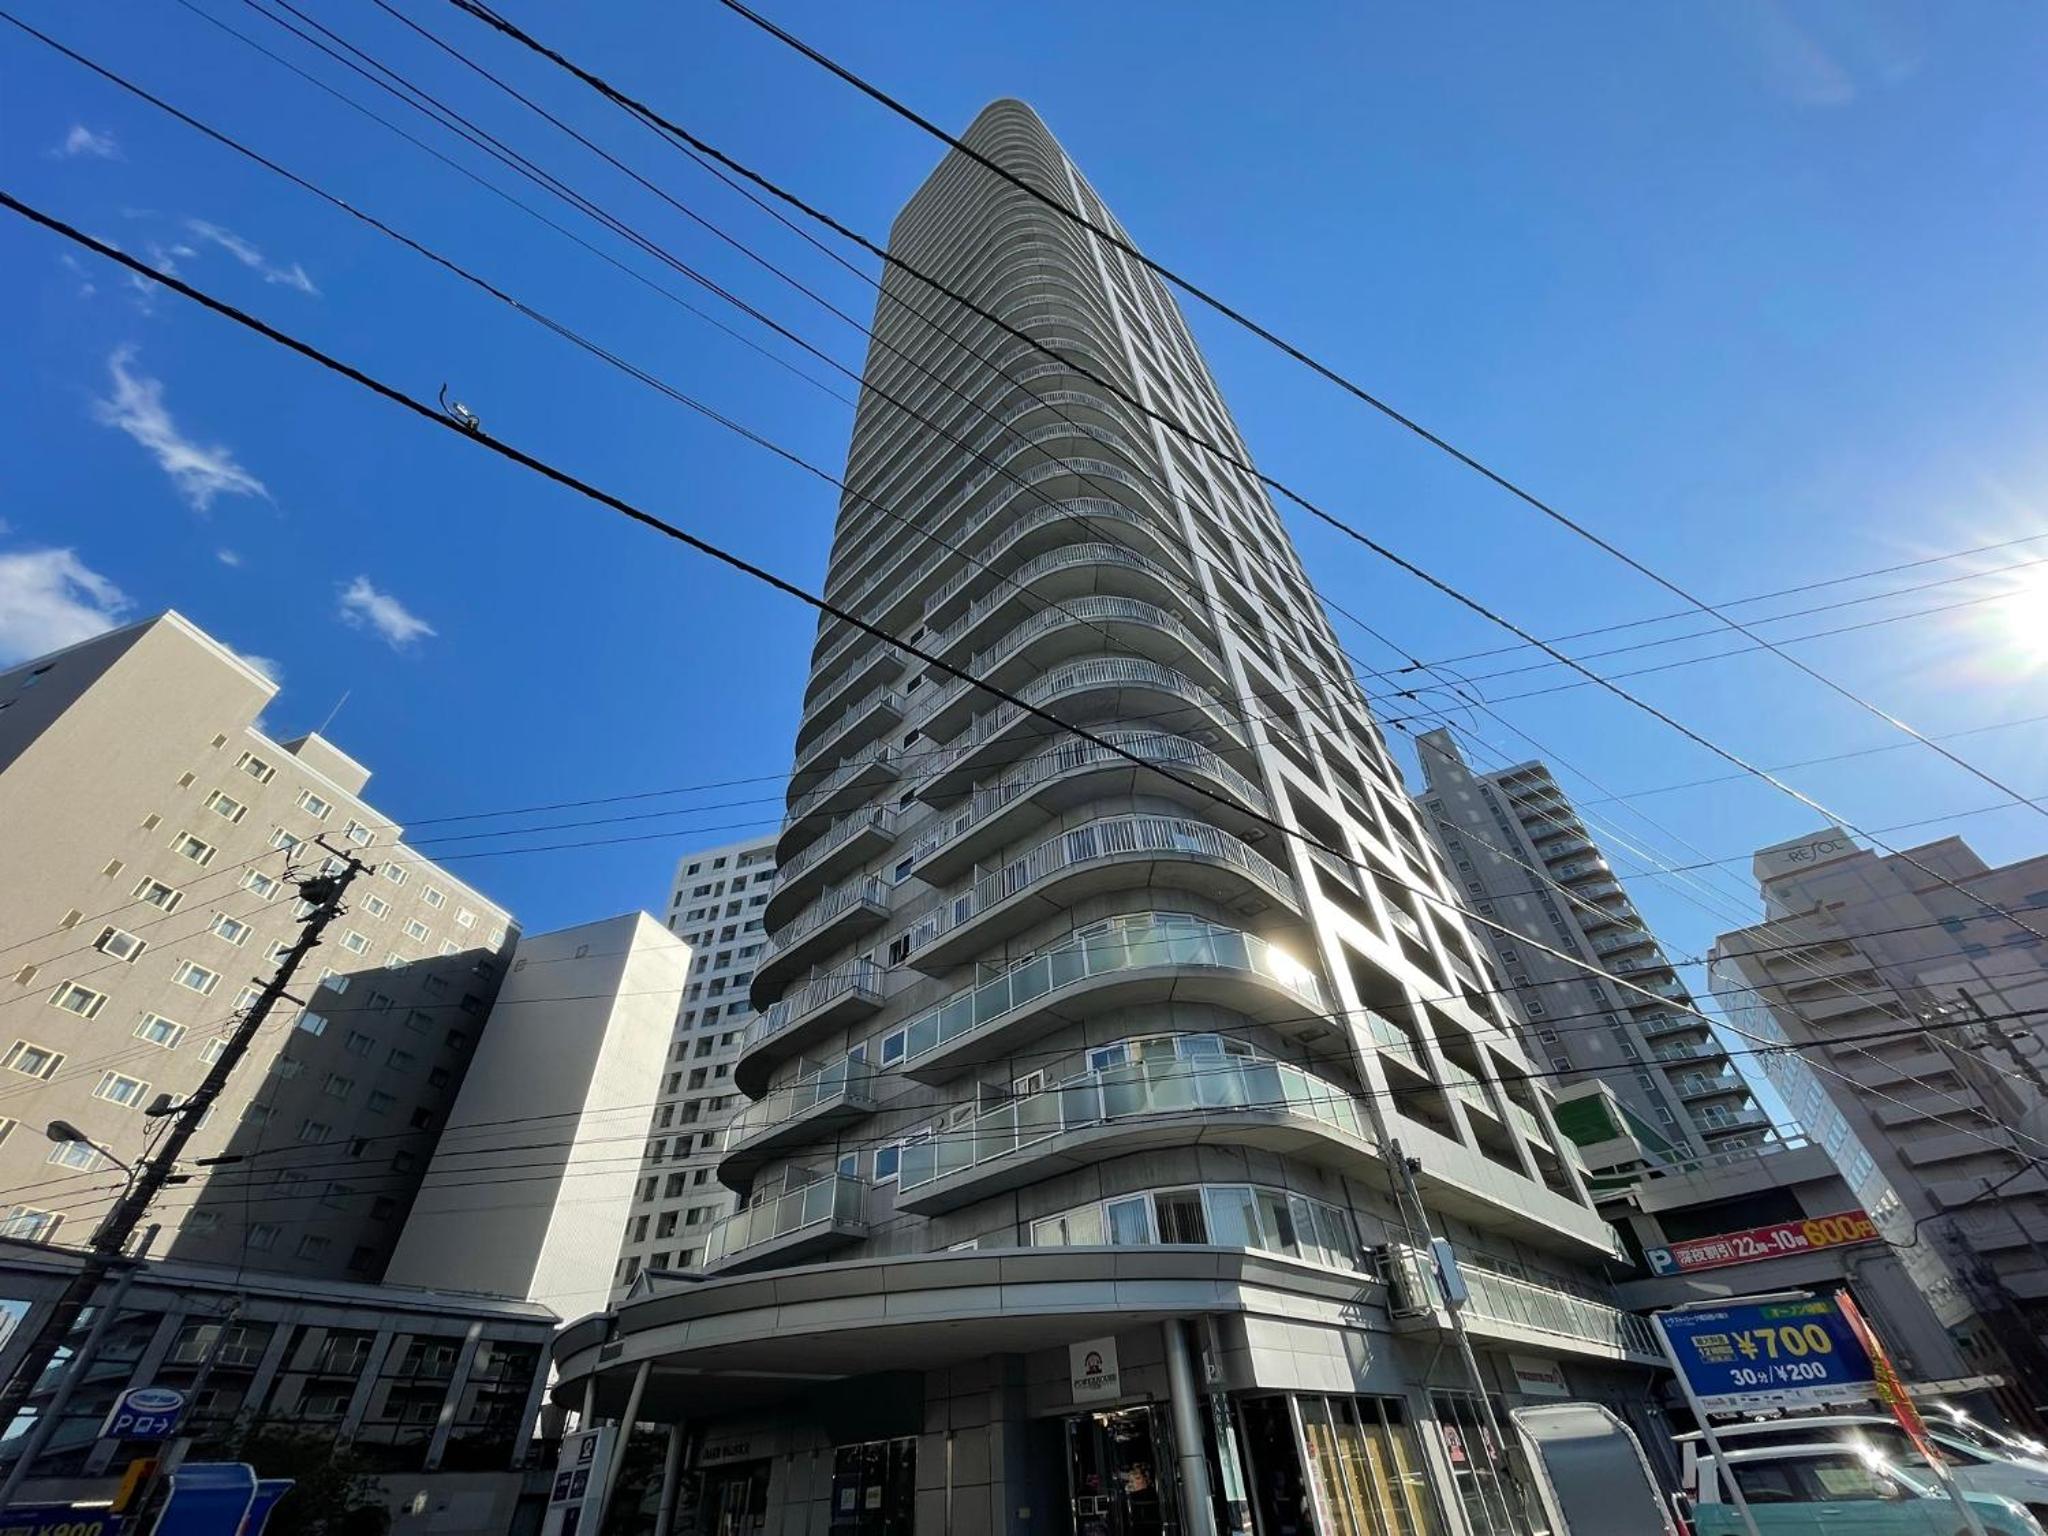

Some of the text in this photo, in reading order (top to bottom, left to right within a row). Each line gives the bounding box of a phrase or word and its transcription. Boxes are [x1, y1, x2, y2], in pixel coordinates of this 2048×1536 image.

[1789, 840, 1844, 863] RESOL
[1648, 1249, 1672, 1274] P
[1732, 1323, 1832, 1361] ¥700
[113, 1414, 134, 1433] P
